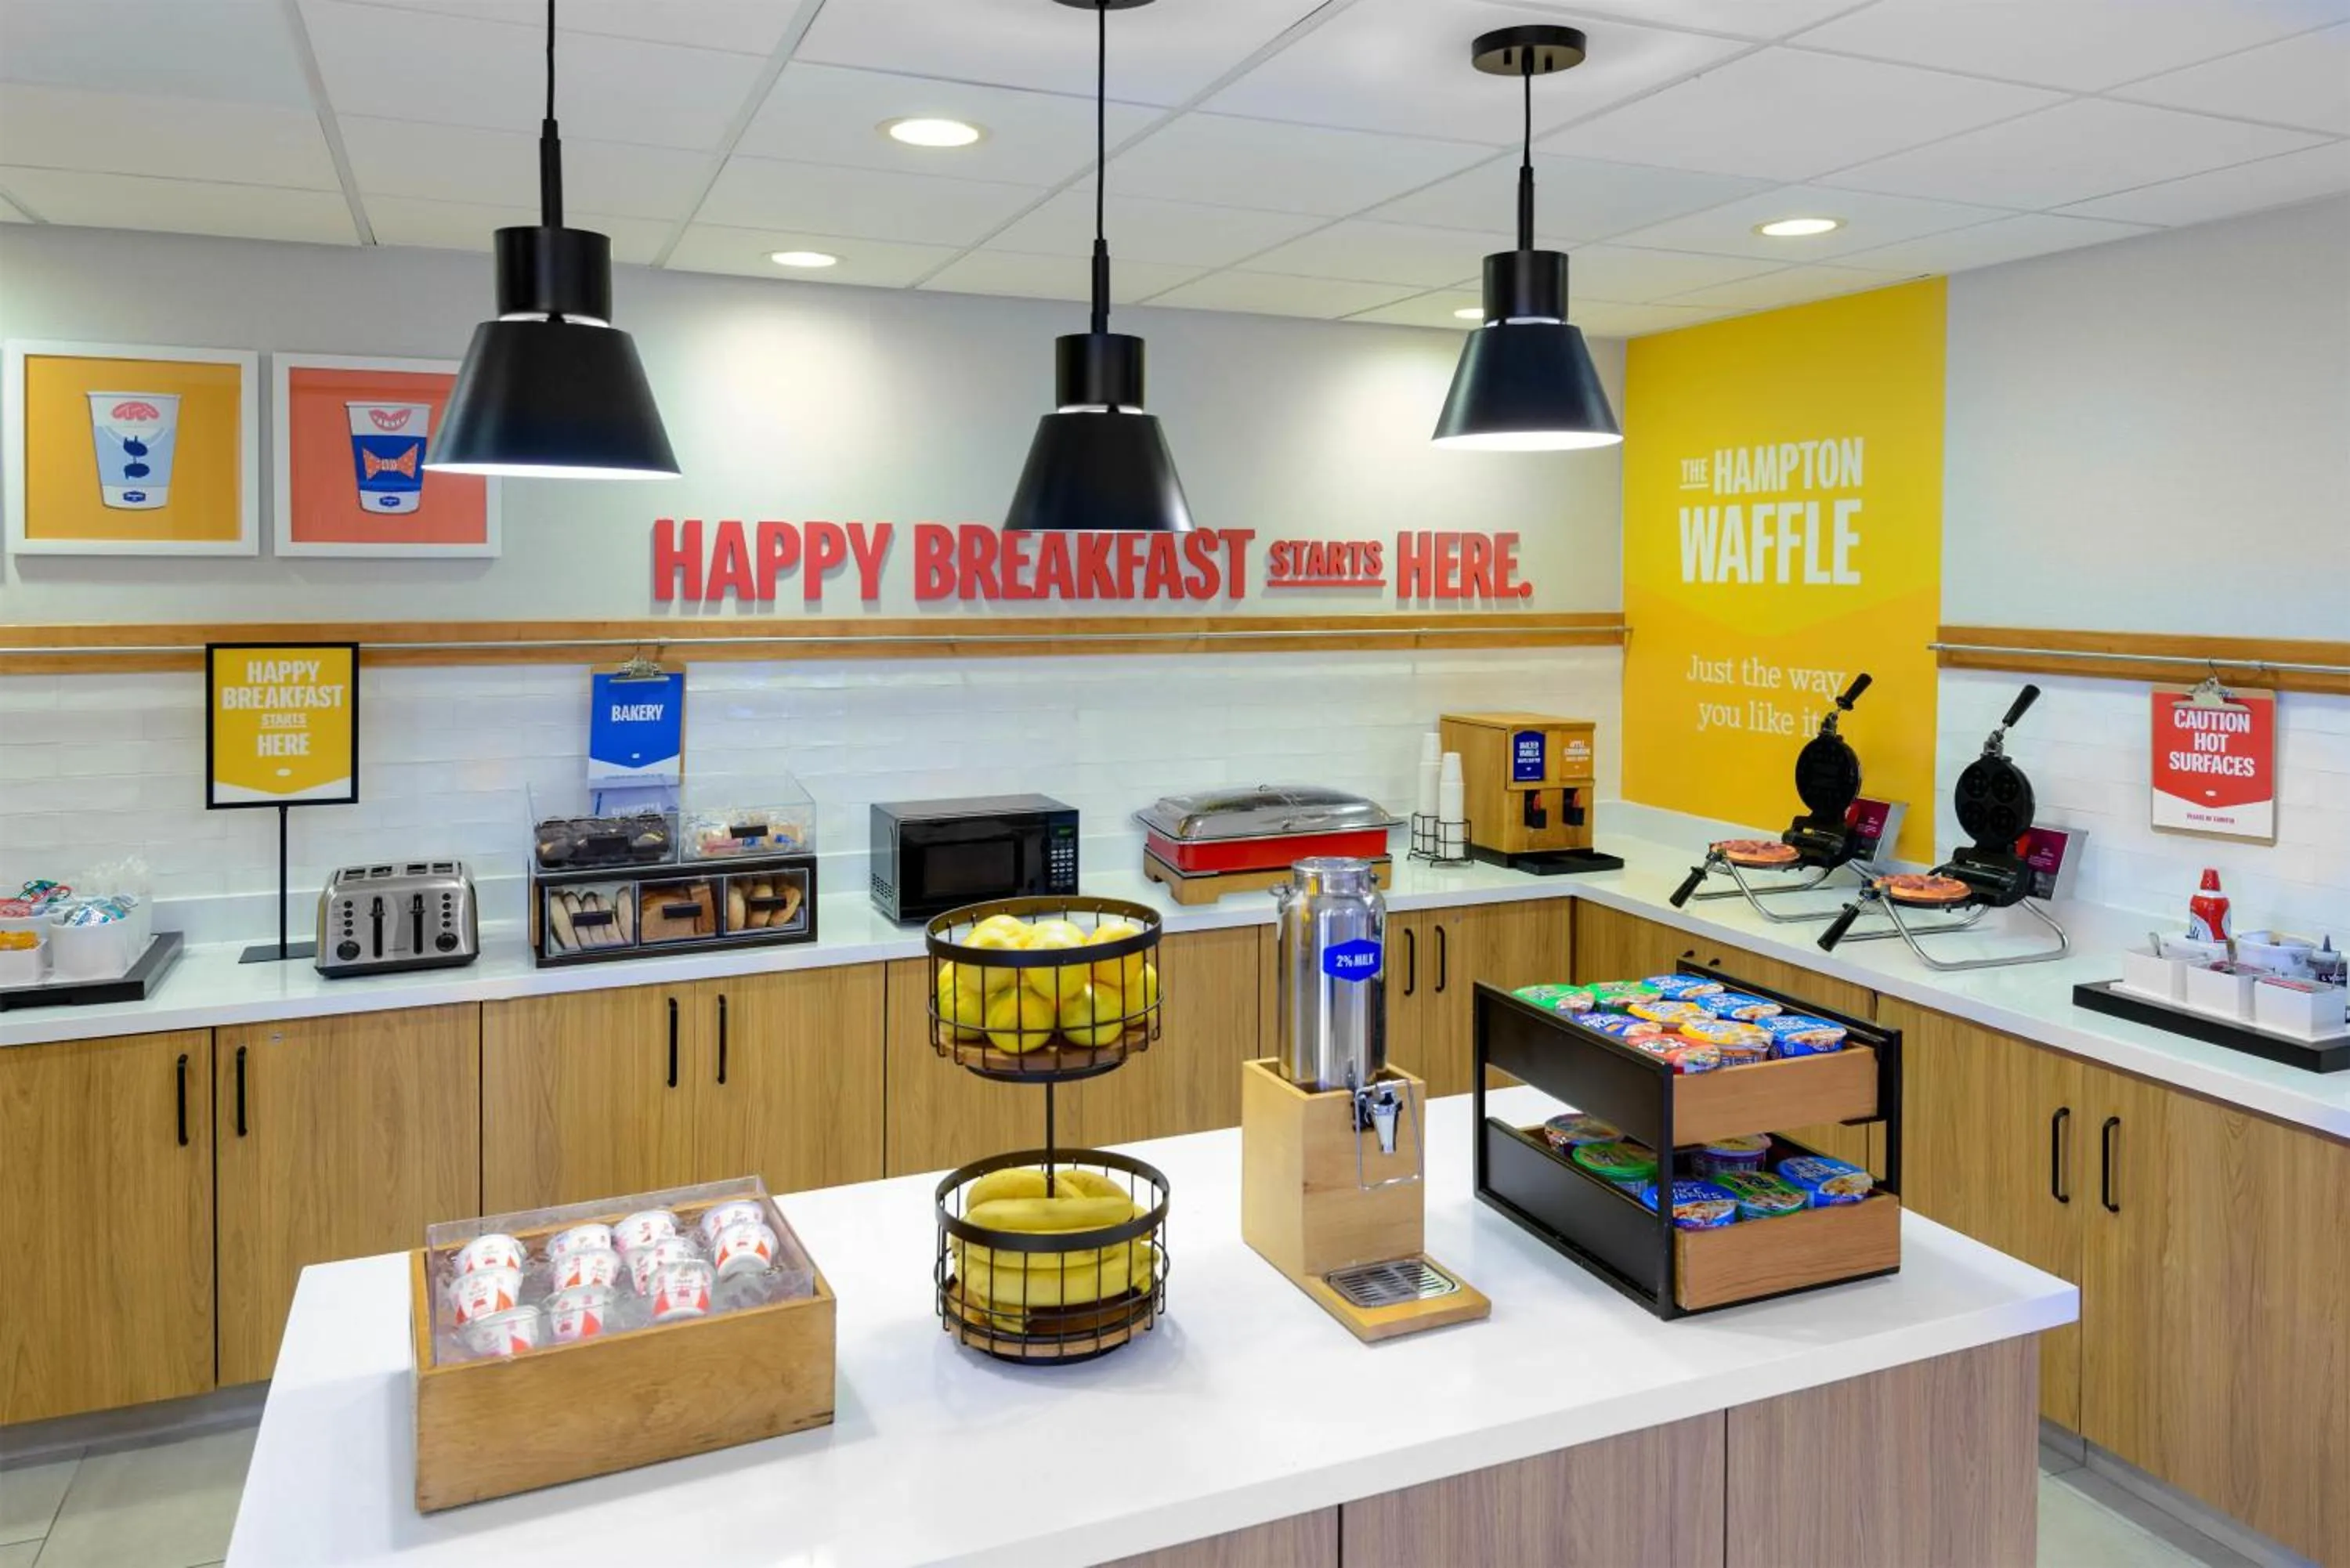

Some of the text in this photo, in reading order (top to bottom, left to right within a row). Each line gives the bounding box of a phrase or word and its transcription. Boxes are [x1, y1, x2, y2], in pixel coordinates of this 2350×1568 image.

[1680, 437, 1864, 495] THE HAMPTON
[1679, 499, 1862, 586] WAFFLE
[654, 519, 1534, 602] HAPPY BREAKFAST STARTS HERE.
[247, 660, 320, 684] HAPPY
[1687, 655, 1846, 703] Just the way
[222, 685, 343, 709] BREAKFAST
[261, 713, 307, 726] STARTS
[611, 704, 663, 721] BAKERY
[1697, 702, 1743, 732] you
[1748, 700, 1795, 735] like
[2174, 709, 2251, 734] CAUTION
[257, 732, 310, 757] HERE
[2193, 732, 2229, 753] HOT
[2169, 752, 2255, 777] SURFACES
[1336, 955, 1353, 966] 2%
